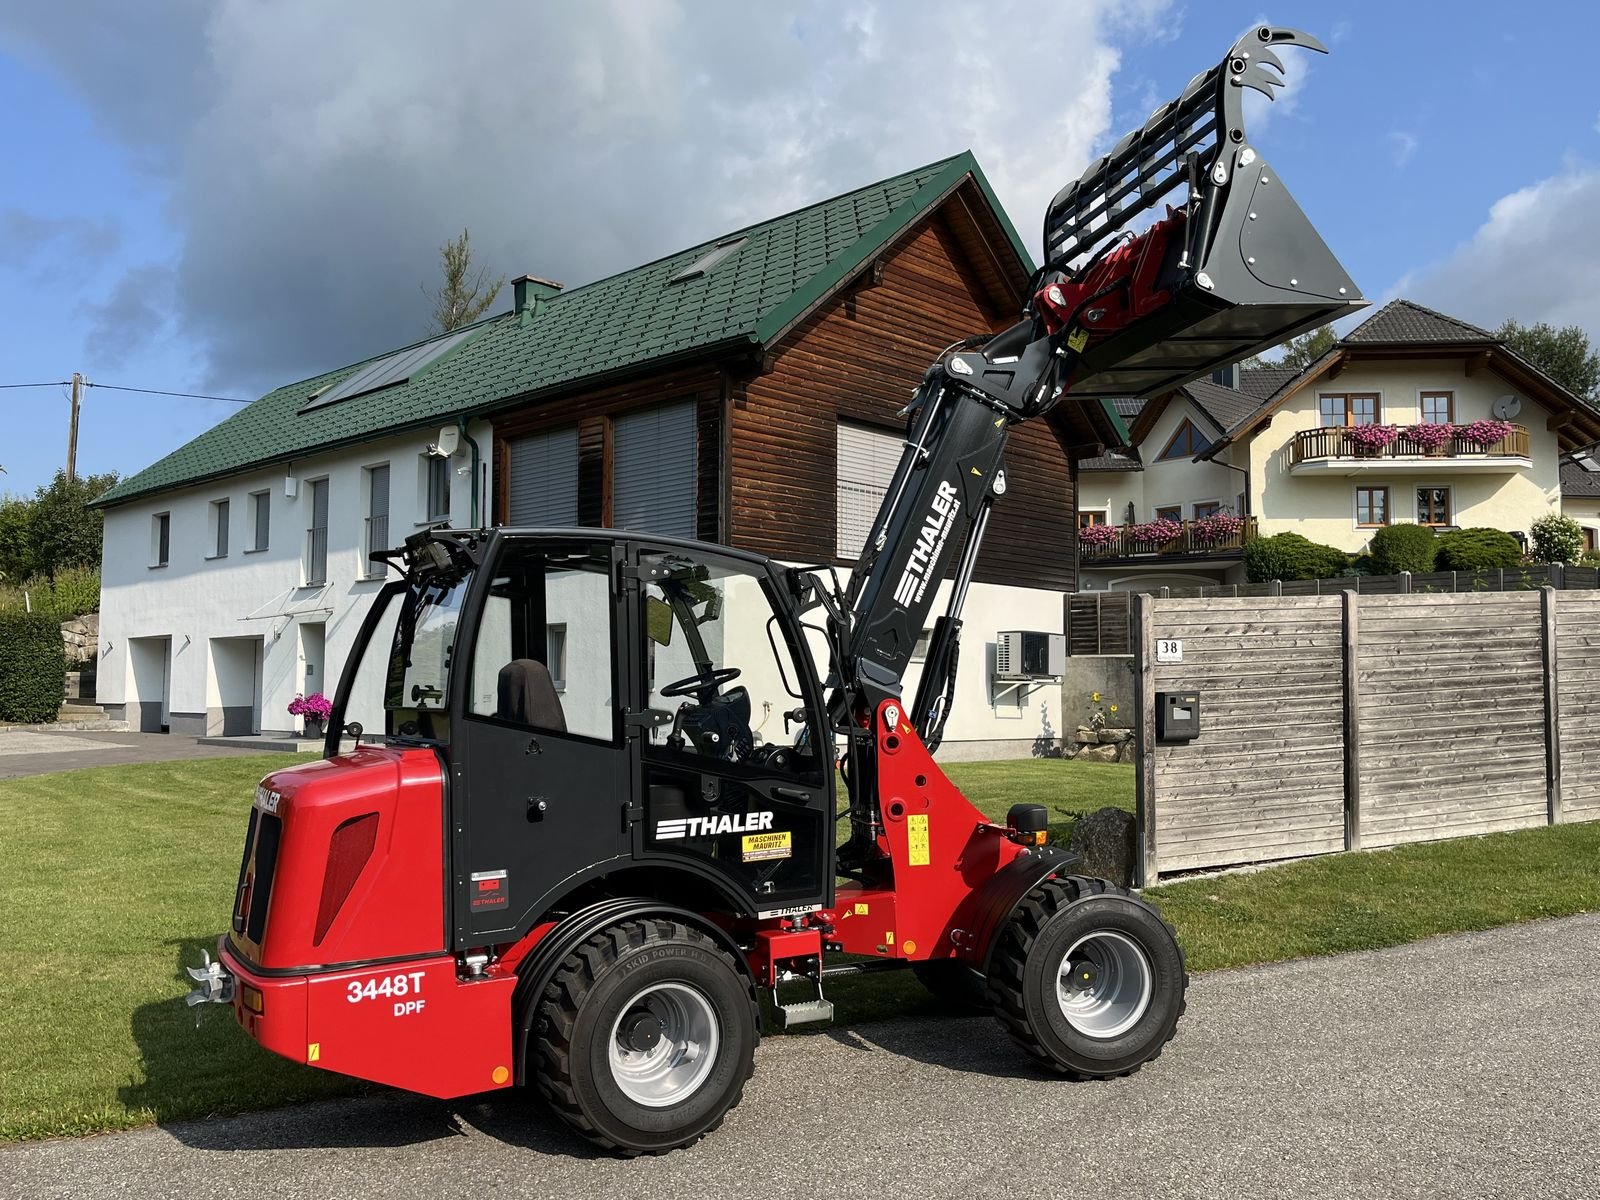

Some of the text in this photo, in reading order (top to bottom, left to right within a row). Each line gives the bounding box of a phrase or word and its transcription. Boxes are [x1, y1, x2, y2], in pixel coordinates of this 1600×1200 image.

[905, 480, 957, 574] THALER
[914, 499, 961, 603] www.maschinen-mauritz.at
[1162, 641, 1177, 654] 38
[687, 811, 774, 837] THALER
[748, 833, 787, 844] MASCHINEN
[753, 841, 782, 850] MAURITZ
[481, 897, 505, 905] THALER
[626, 954, 649, 970] SKID
[652, 948, 687, 959] POWER
[346, 971, 426, 1004] 3448T
[393, 999, 426, 1017] DPF
